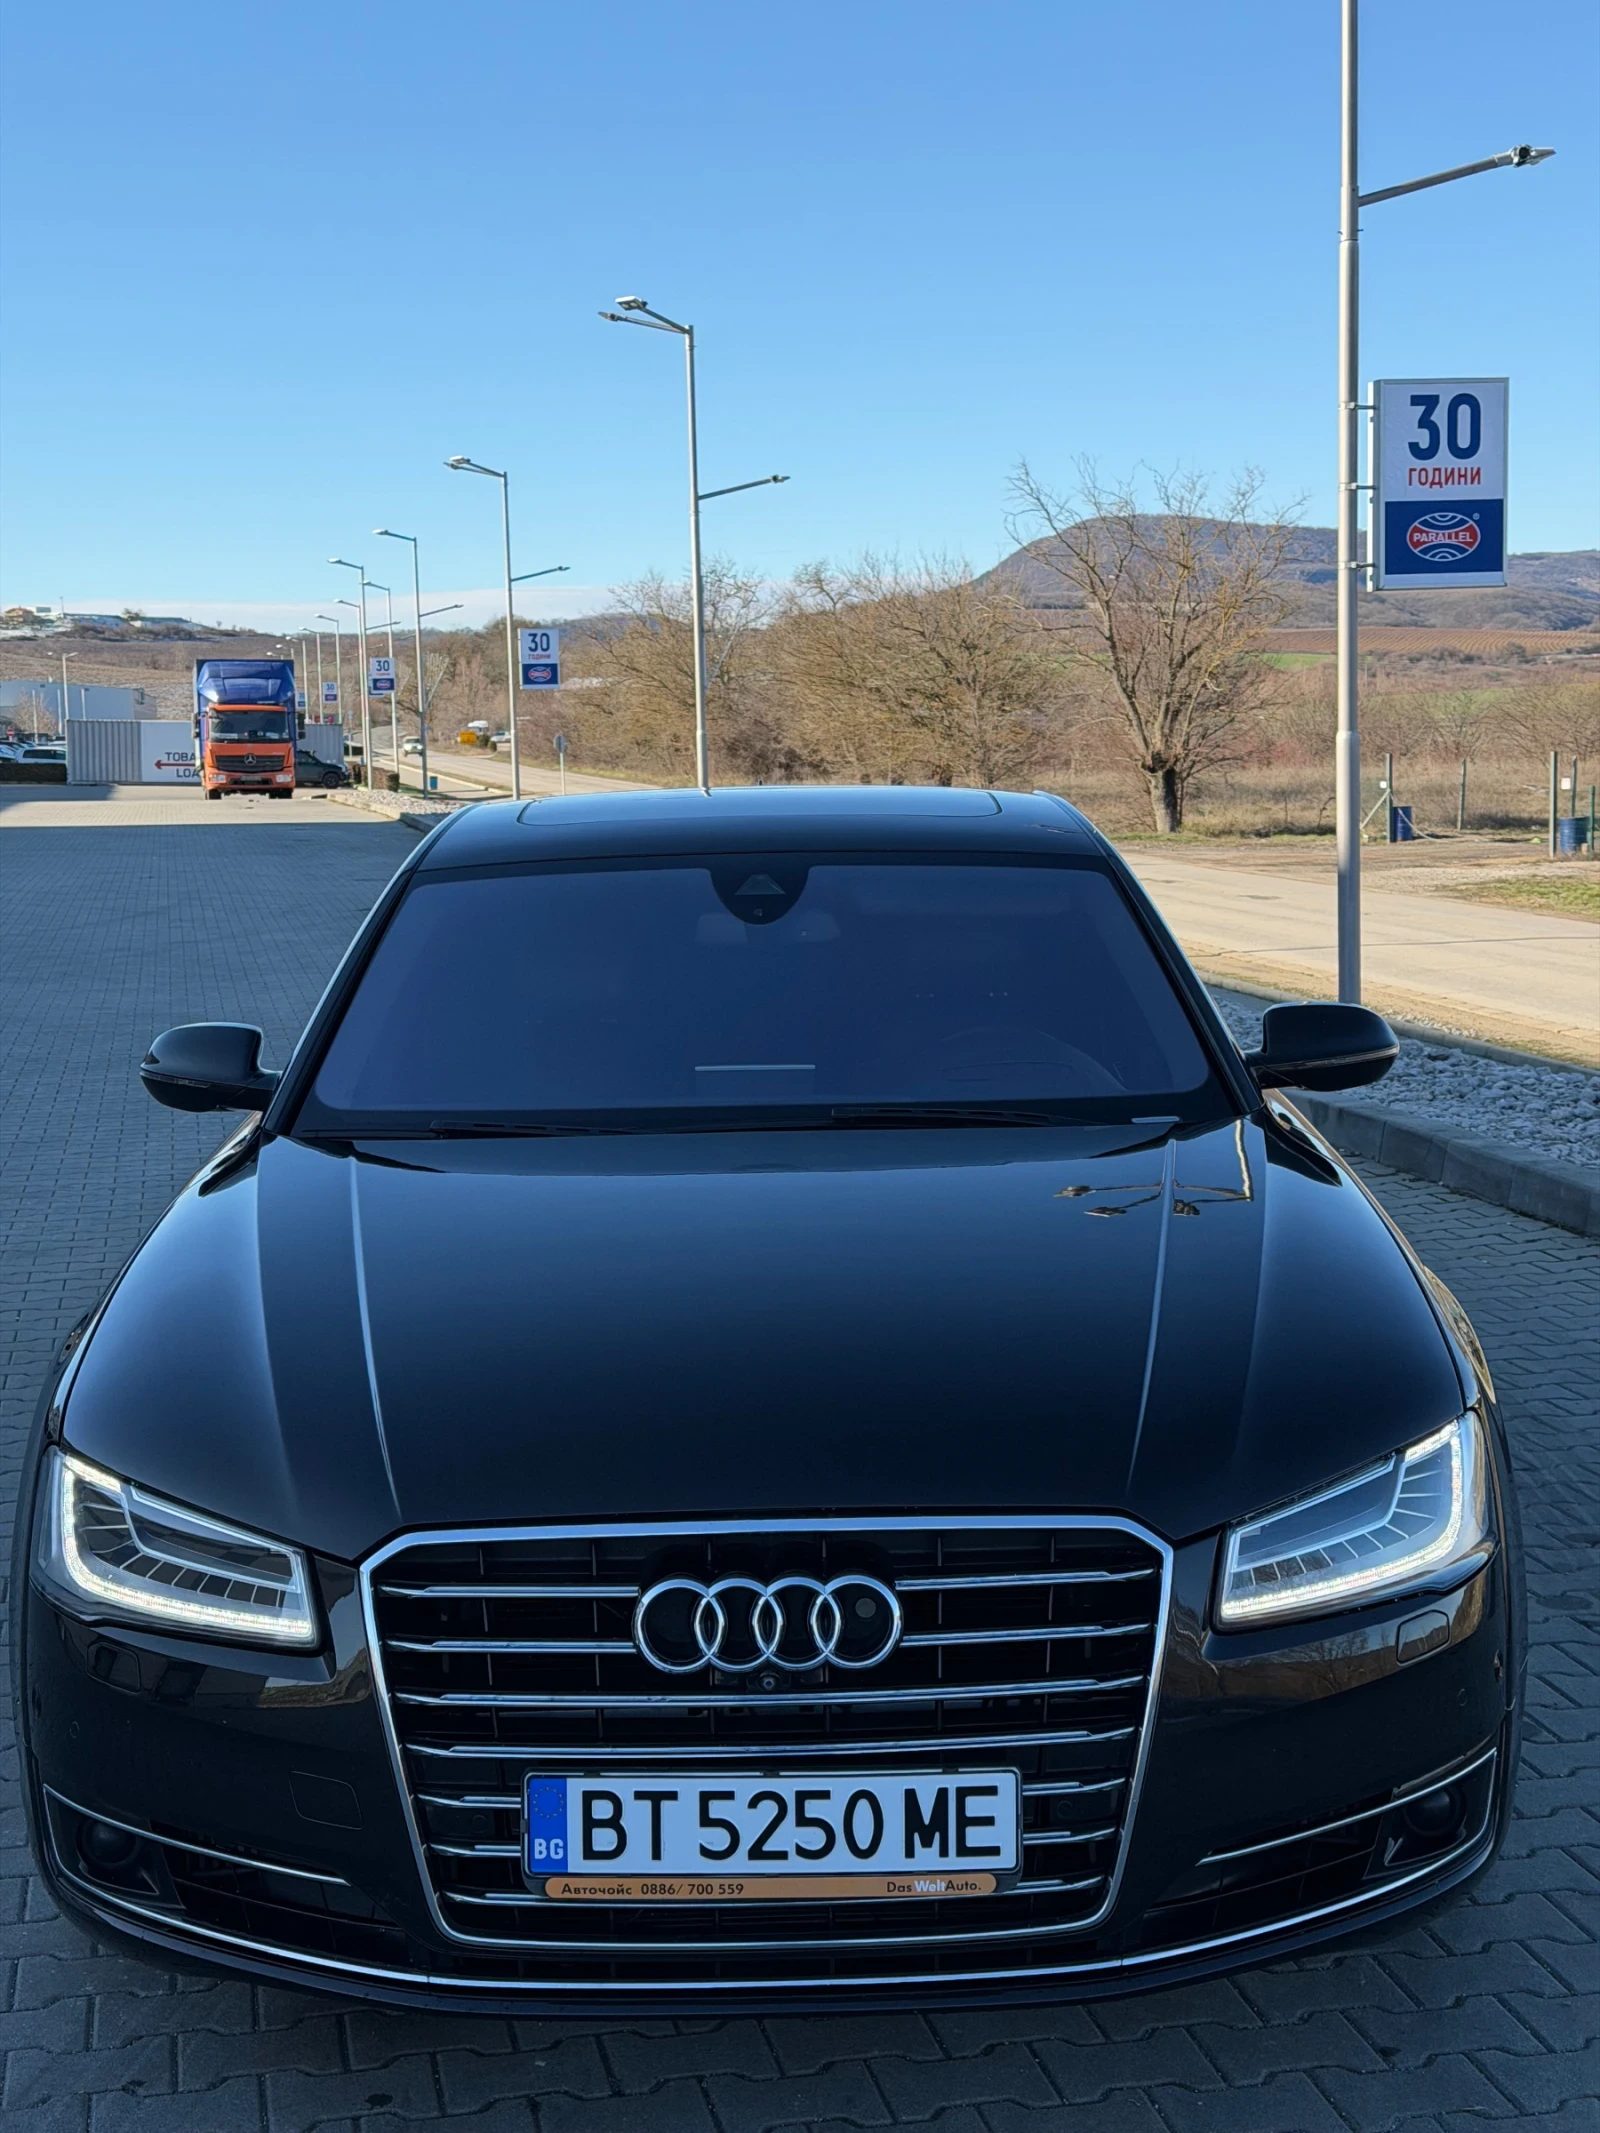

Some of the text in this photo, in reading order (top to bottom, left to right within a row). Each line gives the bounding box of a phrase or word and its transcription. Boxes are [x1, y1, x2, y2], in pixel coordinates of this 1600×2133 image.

[1408, 393, 1481, 461] 30
[1408, 467, 1481, 488] ГОДИНИ
[1413, 532, 1473, 543] PARALLEL
[528, 632, 550, 652] 30
[375, 660, 390, 671] 30
[582, 1785, 1001, 1861] BT 5250 ME
[534, 1838, 564, 1859] BG
[561, 1883, 632, 1895] Авточойс
[688, 1883, 714, 1895] 700
[718, 1883, 744, 1895] 559
[886, 1881, 913, 1893] Das
